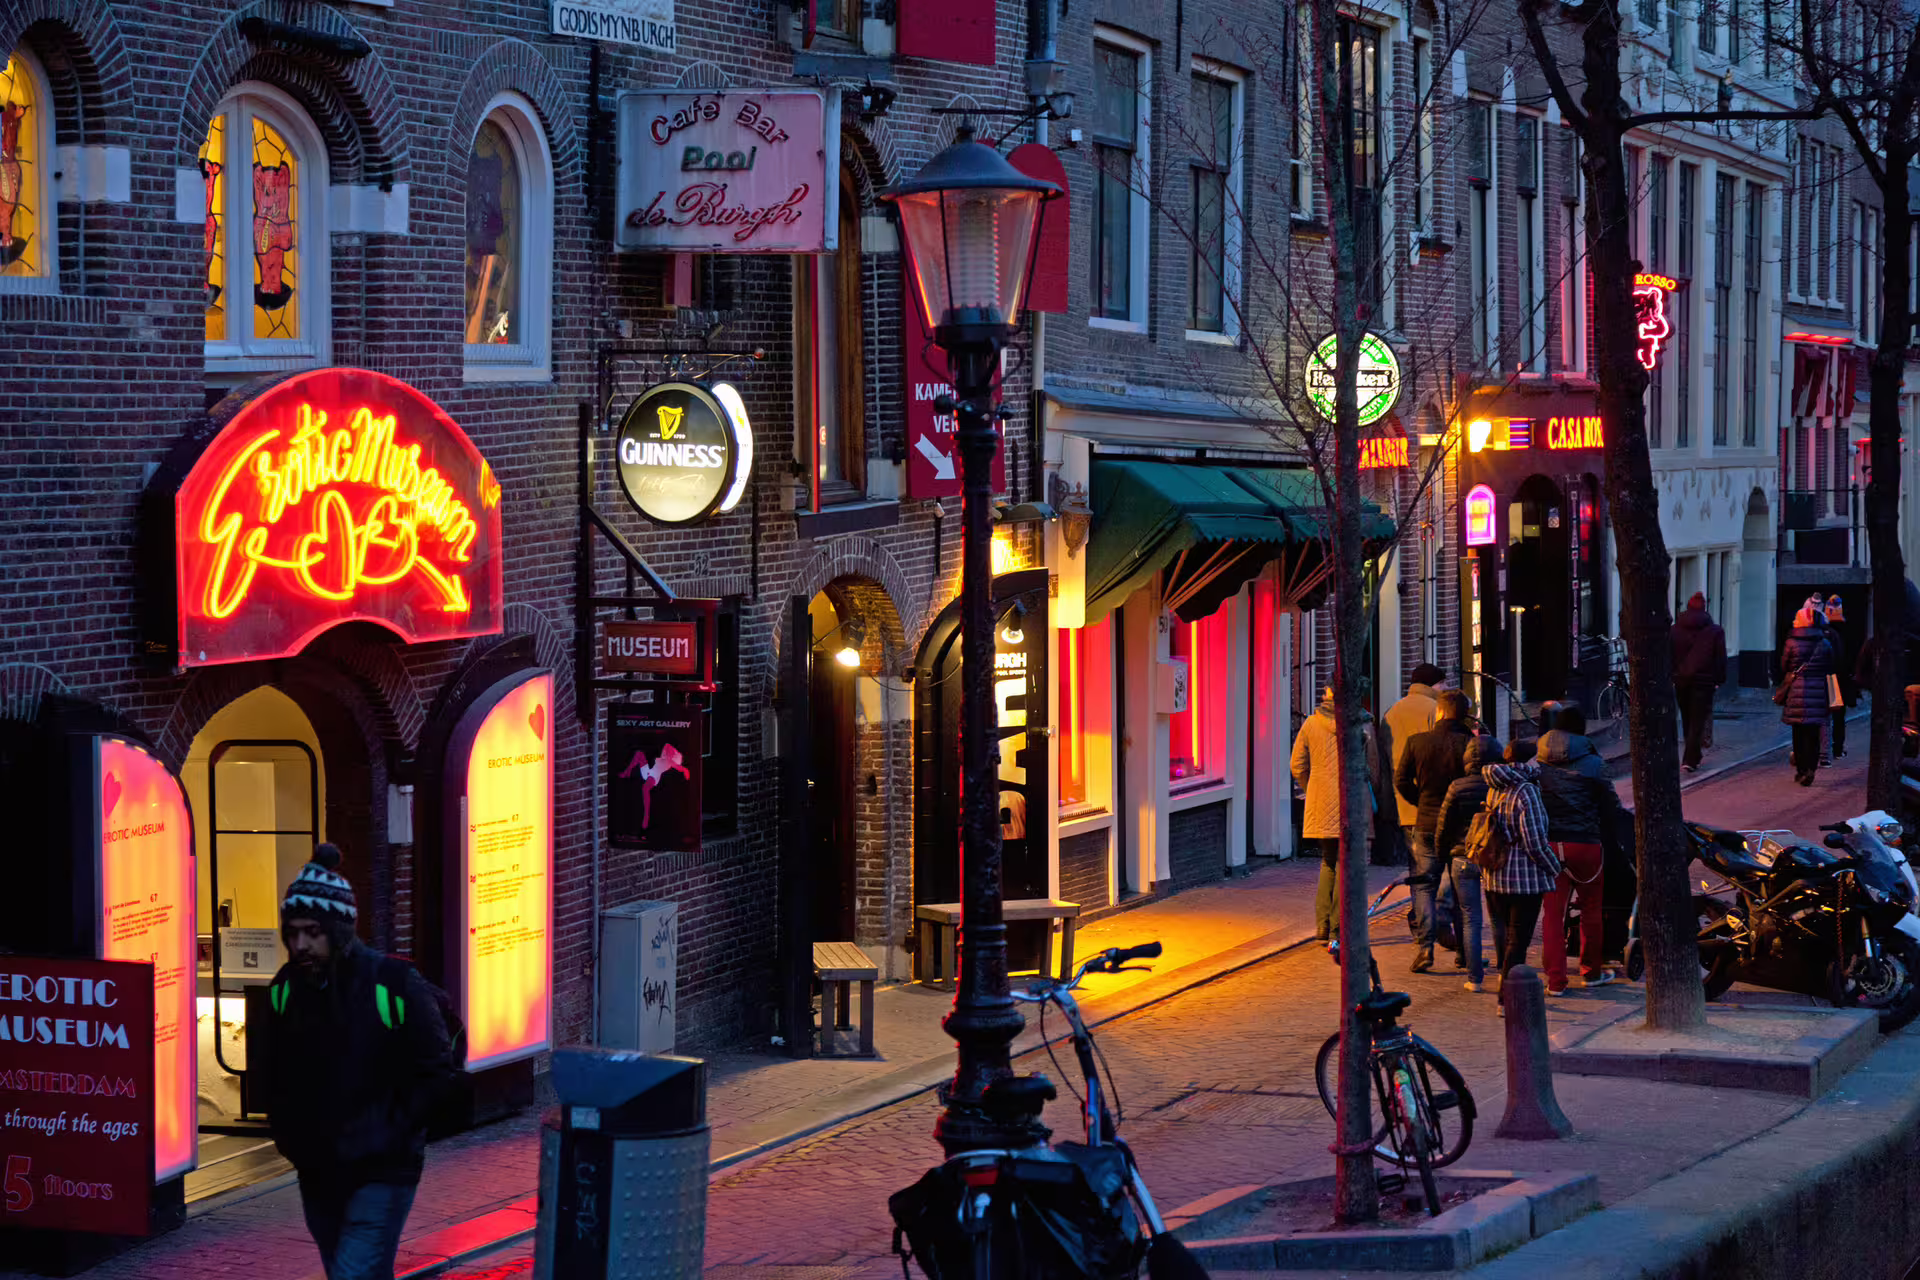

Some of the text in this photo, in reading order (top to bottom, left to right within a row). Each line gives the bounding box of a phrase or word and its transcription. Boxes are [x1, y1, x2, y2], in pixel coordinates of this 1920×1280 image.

[736, 101, 789, 144] Bar
[681, 146, 757, 172] Pool
[626, 182, 809, 242] de Burgh
[1635, 274, 1676, 291] ROSSO
[1548, 416, 1583, 450] CASA
[621, 438, 723, 468] GUINNESS
[608, 636, 689, 658] MUSEUM
[656, 721, 691, 729] GALLERY
[488, 753, 545, 769] EROTIC MUSEUM
[103, 821, 165, 844] EROTIC MUSEUM
[5, 1108, 139, 1142] through the ages
[4, 1155, 113, 1212] 5 floors
